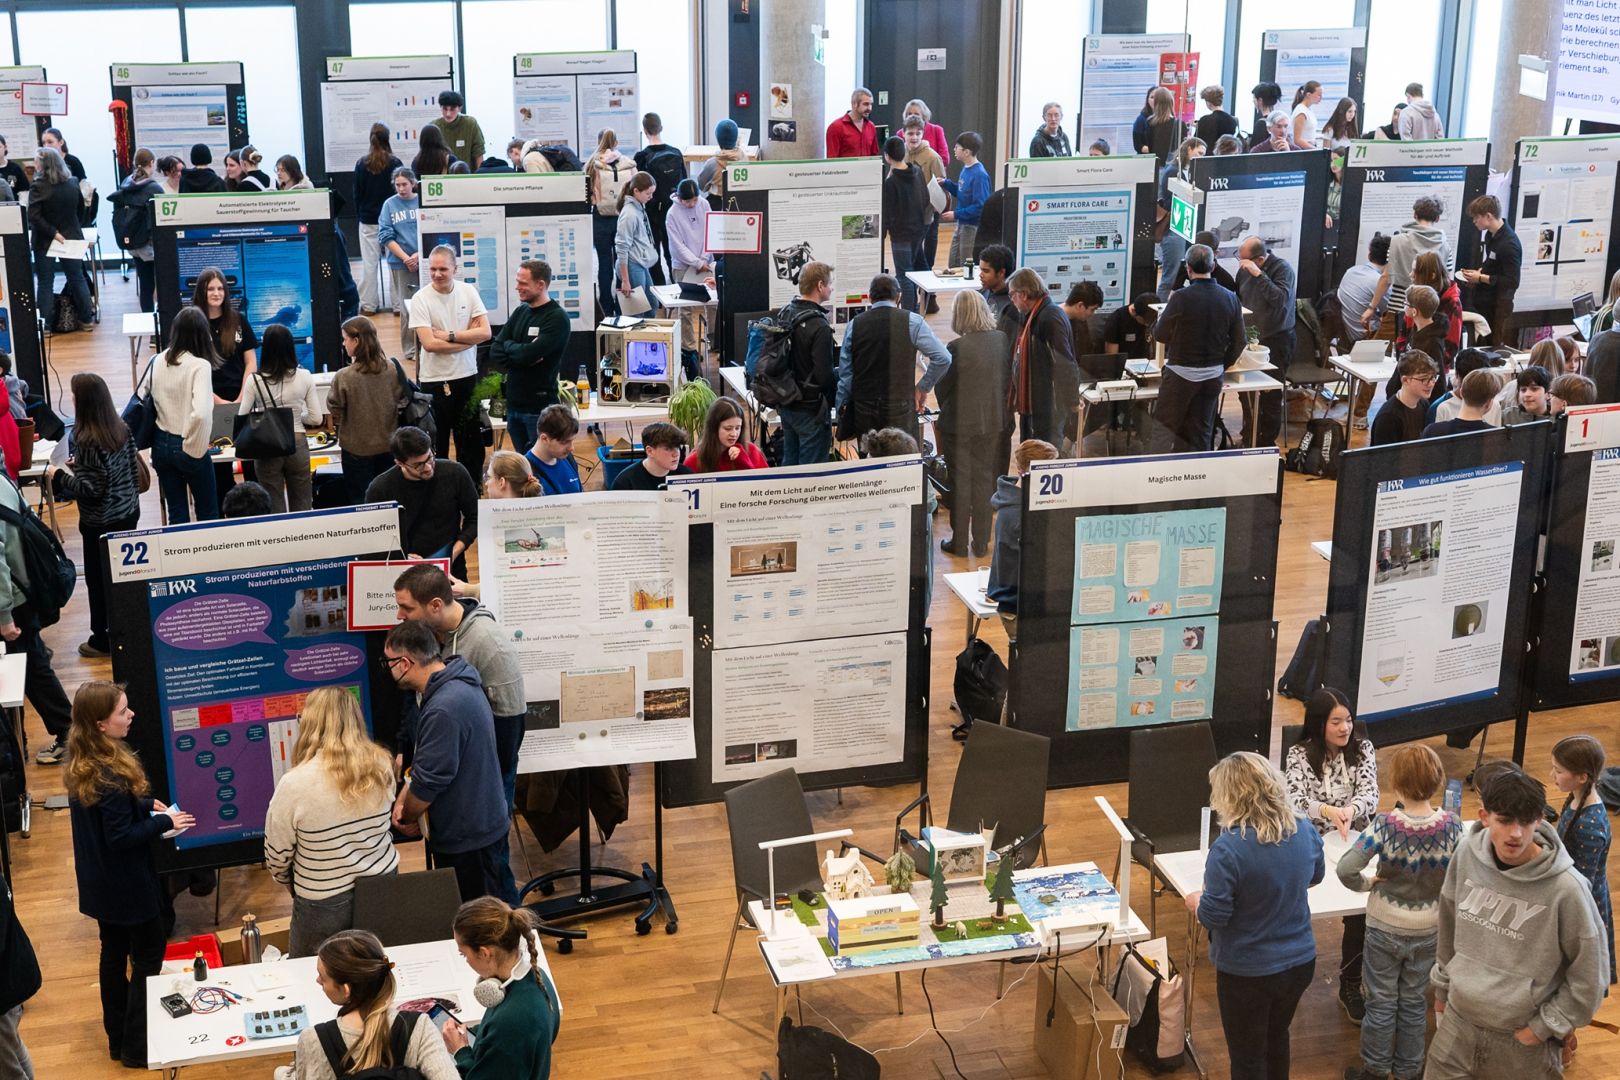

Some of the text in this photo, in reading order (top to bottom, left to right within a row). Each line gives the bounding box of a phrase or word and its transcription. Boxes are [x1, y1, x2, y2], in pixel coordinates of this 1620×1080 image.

[1596, 0, 1617, 10] Licht
[1575, 24, 1608, 35] Molekül
[1269, 33, 1278, 43] 52
[1574, 38, 1620, 48] berechnen
[1089, 40, 1099, 49] 53
[332, 62, 343, 73] 47
[520, 58, 532, 68] 48
[117, 68, 129, 79] 46
[1592, 66, 1610, 74] sah.
[1568, 91, 1590, 100] Martin
[1592, 94, 1604, 102] (17)
[1356, 146, 1367, 158] 71
[1525, 145, 1538, 157] 72
[733, 168, 748, 182] 69
[1014, 165, 1028, 178] 70
[428, 182, 443, 196] 68
[162, 201, 178, 216] 67
[391, 210, 406, 224] SAN
[1582, 418, 1589, 438] 1
[1148, 474, 1182, 484] Magische
[1440, 471, 1474, 482] funktionieren
[1475, 465, 1508, 476] Wasserfilter?
[838, 480, 883, 490] Wellenlänge
[1040, 473, 1063, 496] 20
[769, 496, 808, 505] Forschung
[828, 492, 867, 501] wertvolles
[868, 485, 916, 496] Wellensurfen
[1081, 515, 1217, 546] MAGISCHE MASSE
[192, 542, 245, 554] produzieren
[246, 539, 260, 547] mit
[262, 533, 325, 545] verschiedenen
[326, 523, 397, 537] Naturfarbstoffen
[121, 542, 149, 566] 22
[205, 574, 230, 583] Strom
[232, 570, 279, 582] produzieren
[248, 574, 312, 588] Naturfarbstoffen
[188, 1034, 210, 1045] 22
